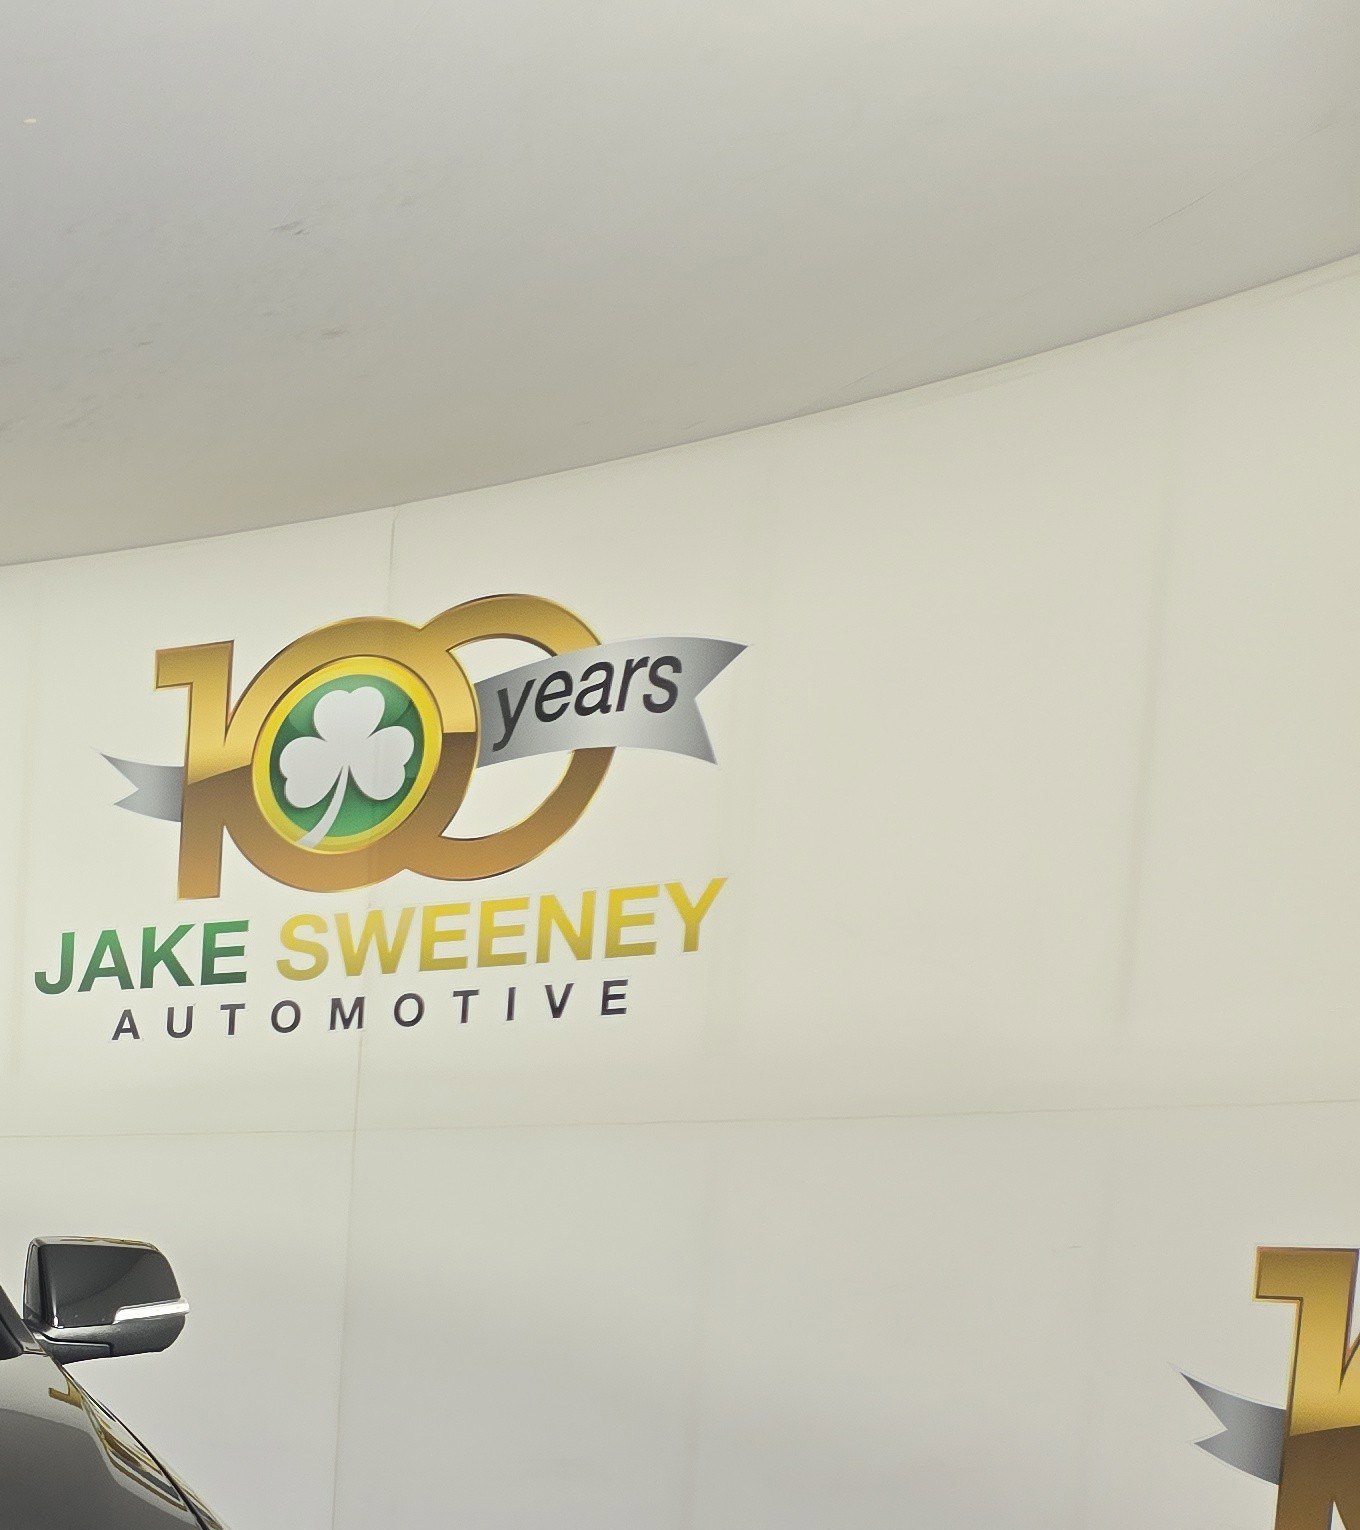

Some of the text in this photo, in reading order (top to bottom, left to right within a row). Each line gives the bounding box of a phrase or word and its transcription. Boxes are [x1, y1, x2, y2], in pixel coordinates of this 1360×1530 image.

[155, 593, 682, 900] 100 years
[34, 876, 728, 995] JAKE SWEENEY
[112, 978, 628, 1041] AUTOMOTIVE
